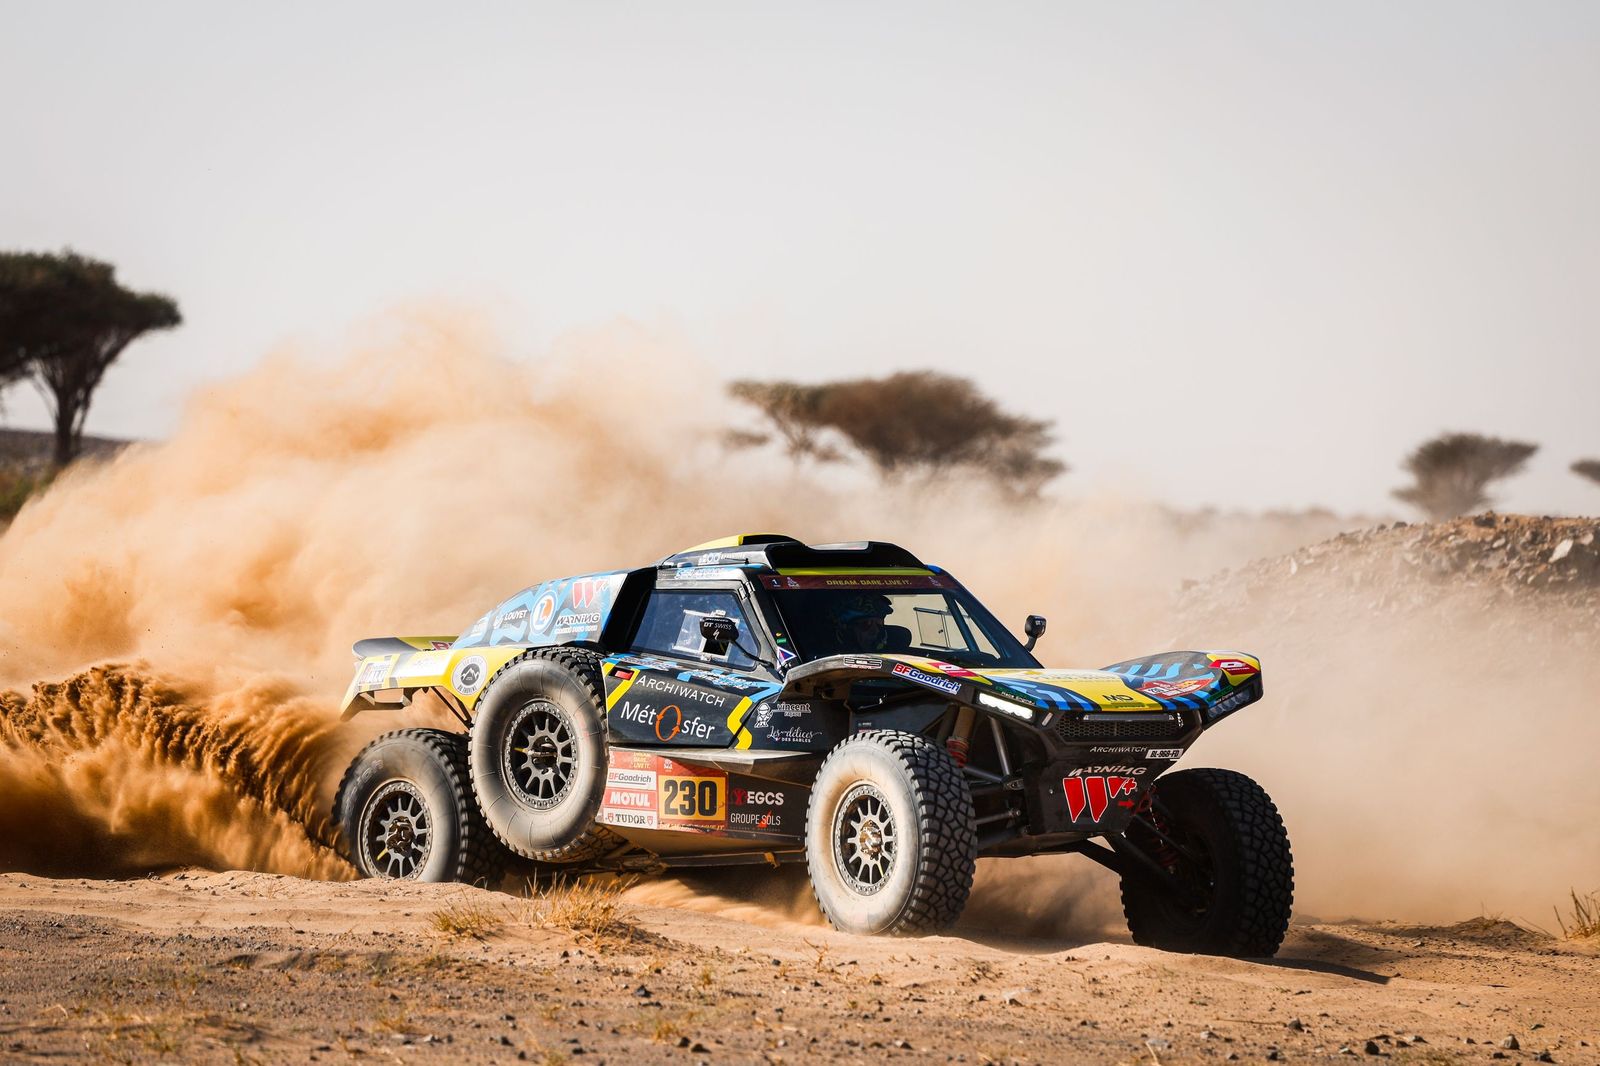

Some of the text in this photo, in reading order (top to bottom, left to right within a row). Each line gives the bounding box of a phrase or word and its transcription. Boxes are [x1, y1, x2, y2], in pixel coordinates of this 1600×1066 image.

[714, 622, 732, 631] SWISS
[893, 662, 961, 692] BFGoodrich
[635, 675, 725, 708] ARCHIWATCH
[776, 701, 811, 712] vincent
[766, 726, 823, 739] Les délices
[608, 772, 652, 783] BFGoodrich
[609, 791, 651, 807] MOTUL
[663, 779, 718, 817] 230
[746, 791, 785, 806] EGCS
[615, 813, 646, 825] TUDOR
[730, 812, 781, 826] GROUPE SOLS
